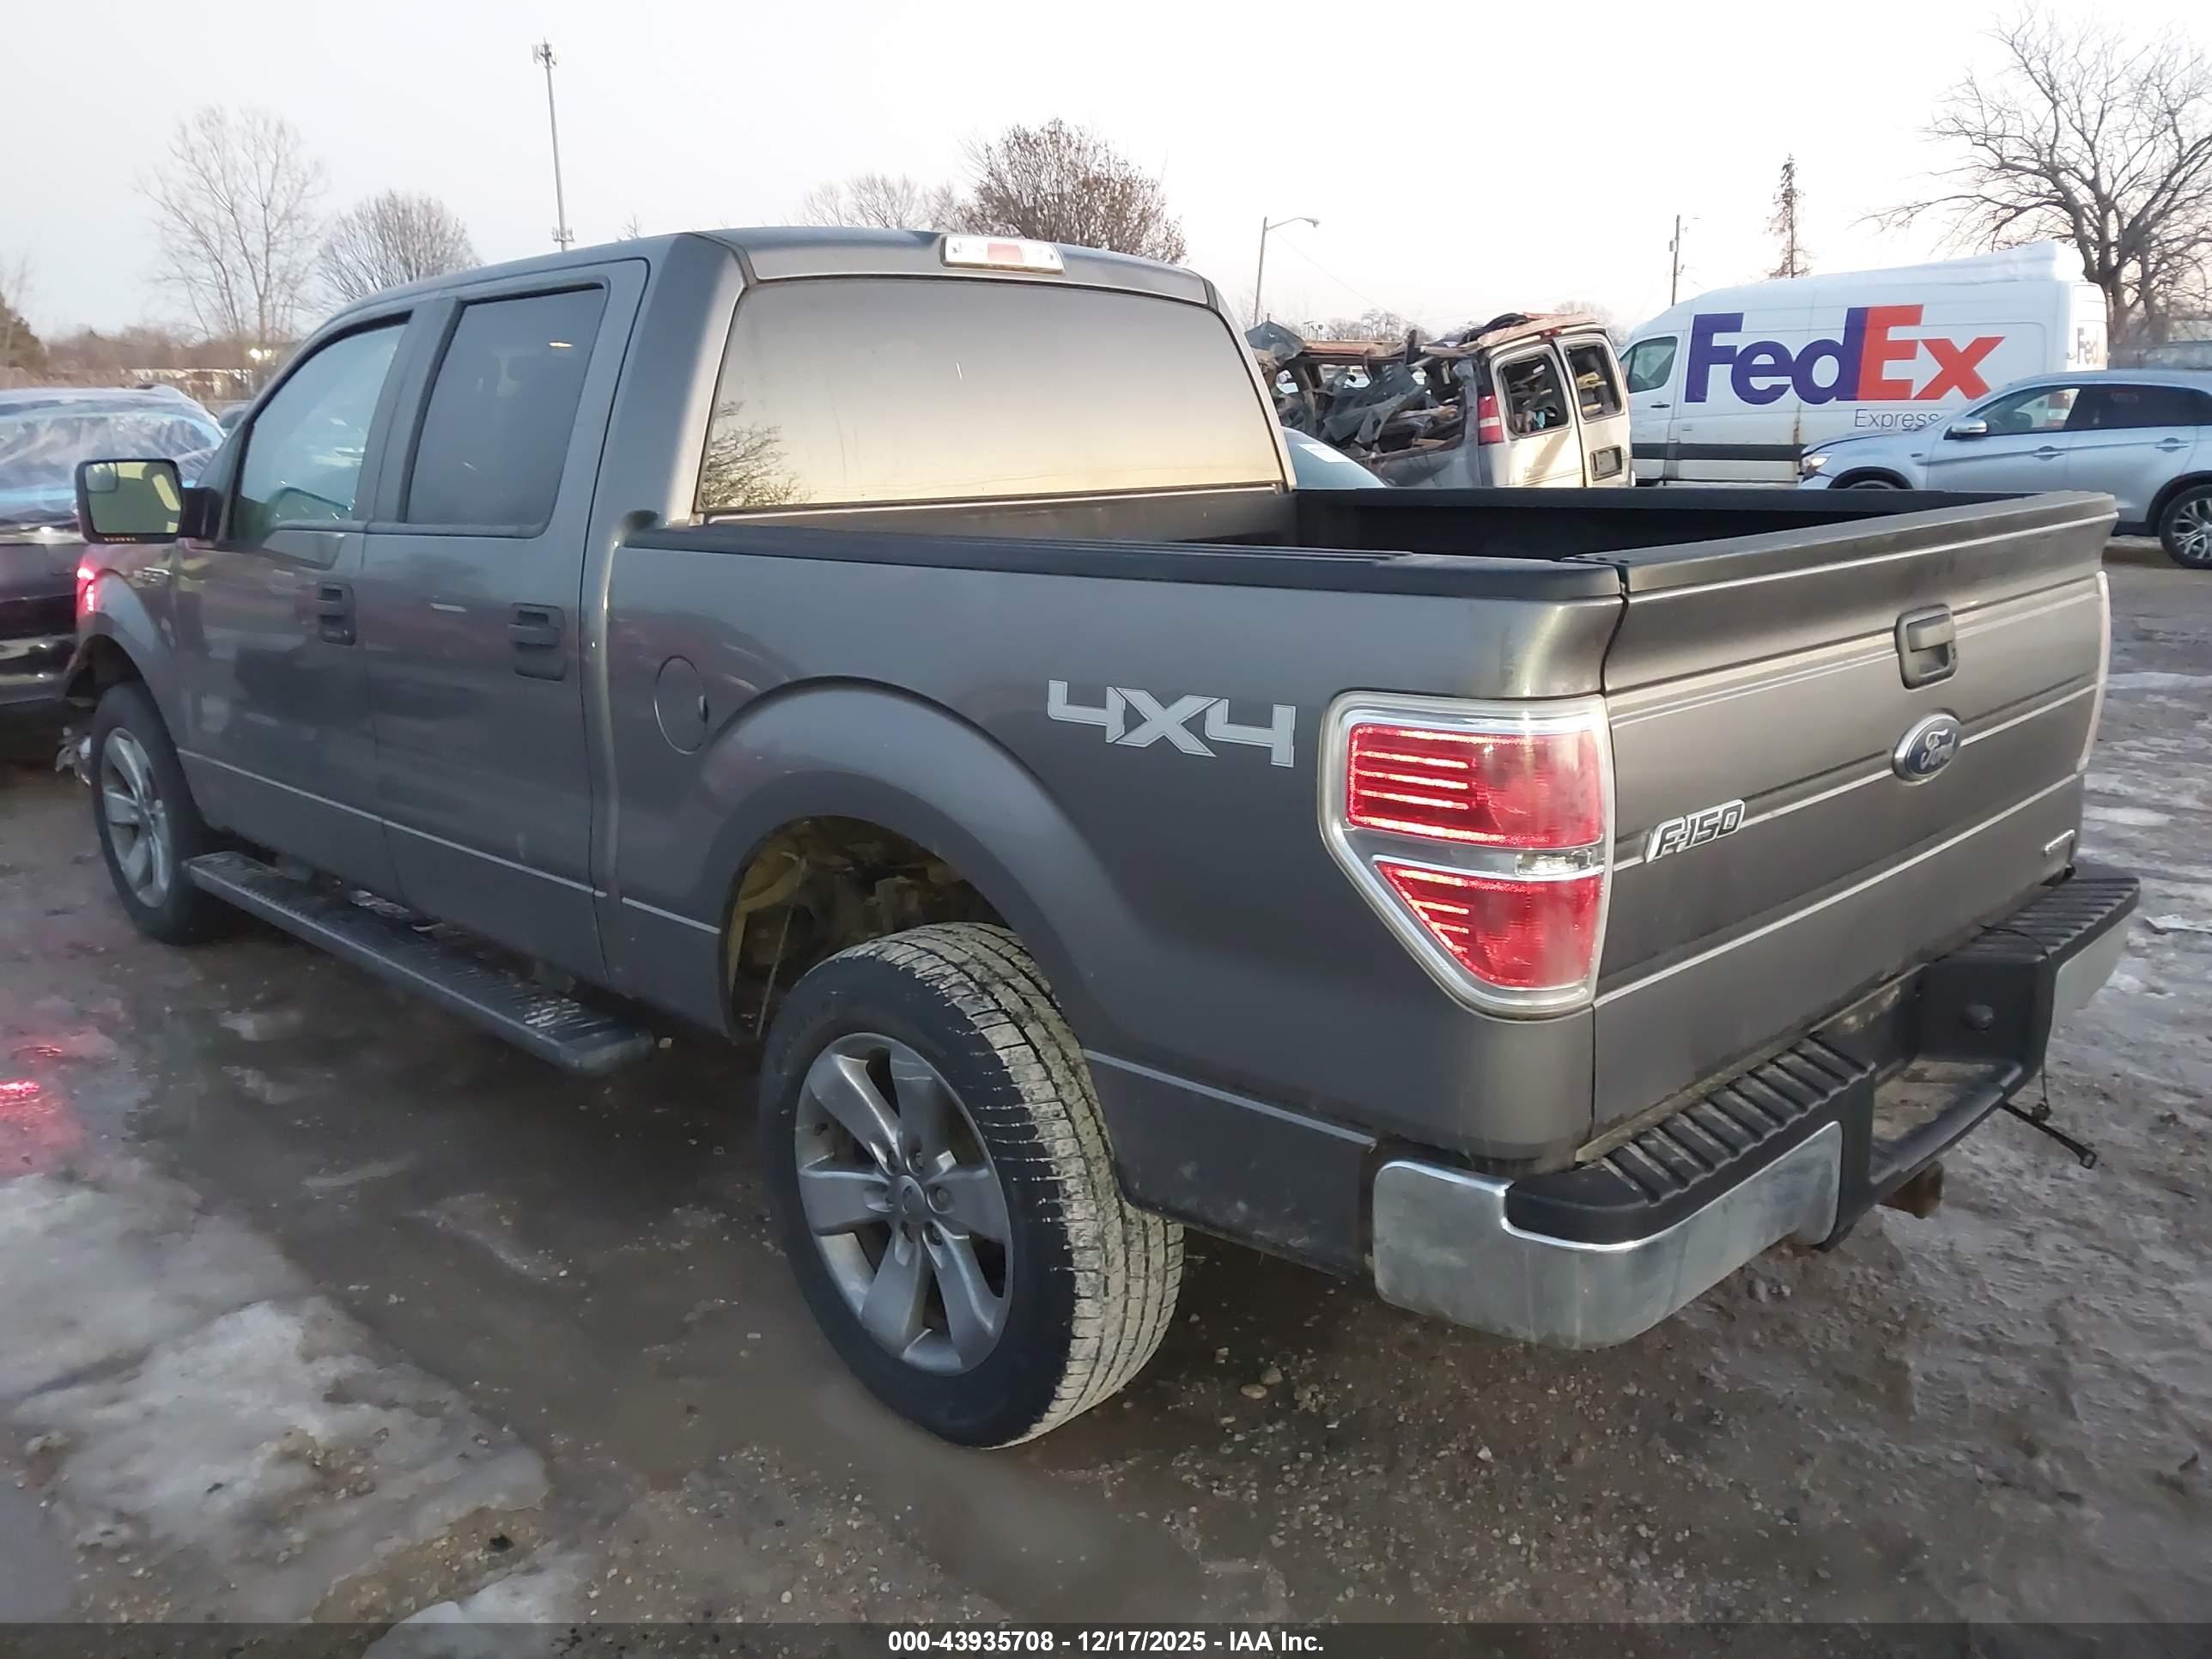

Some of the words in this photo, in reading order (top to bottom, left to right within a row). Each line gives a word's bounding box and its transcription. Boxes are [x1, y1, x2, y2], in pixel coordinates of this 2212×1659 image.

[1685, 304, 2006, 405] FedEx
[1855, 409, 1939, 429] Express
[1920, 728, 1957, 769] Ford
[1646, 799, 1745, 863] F-150
